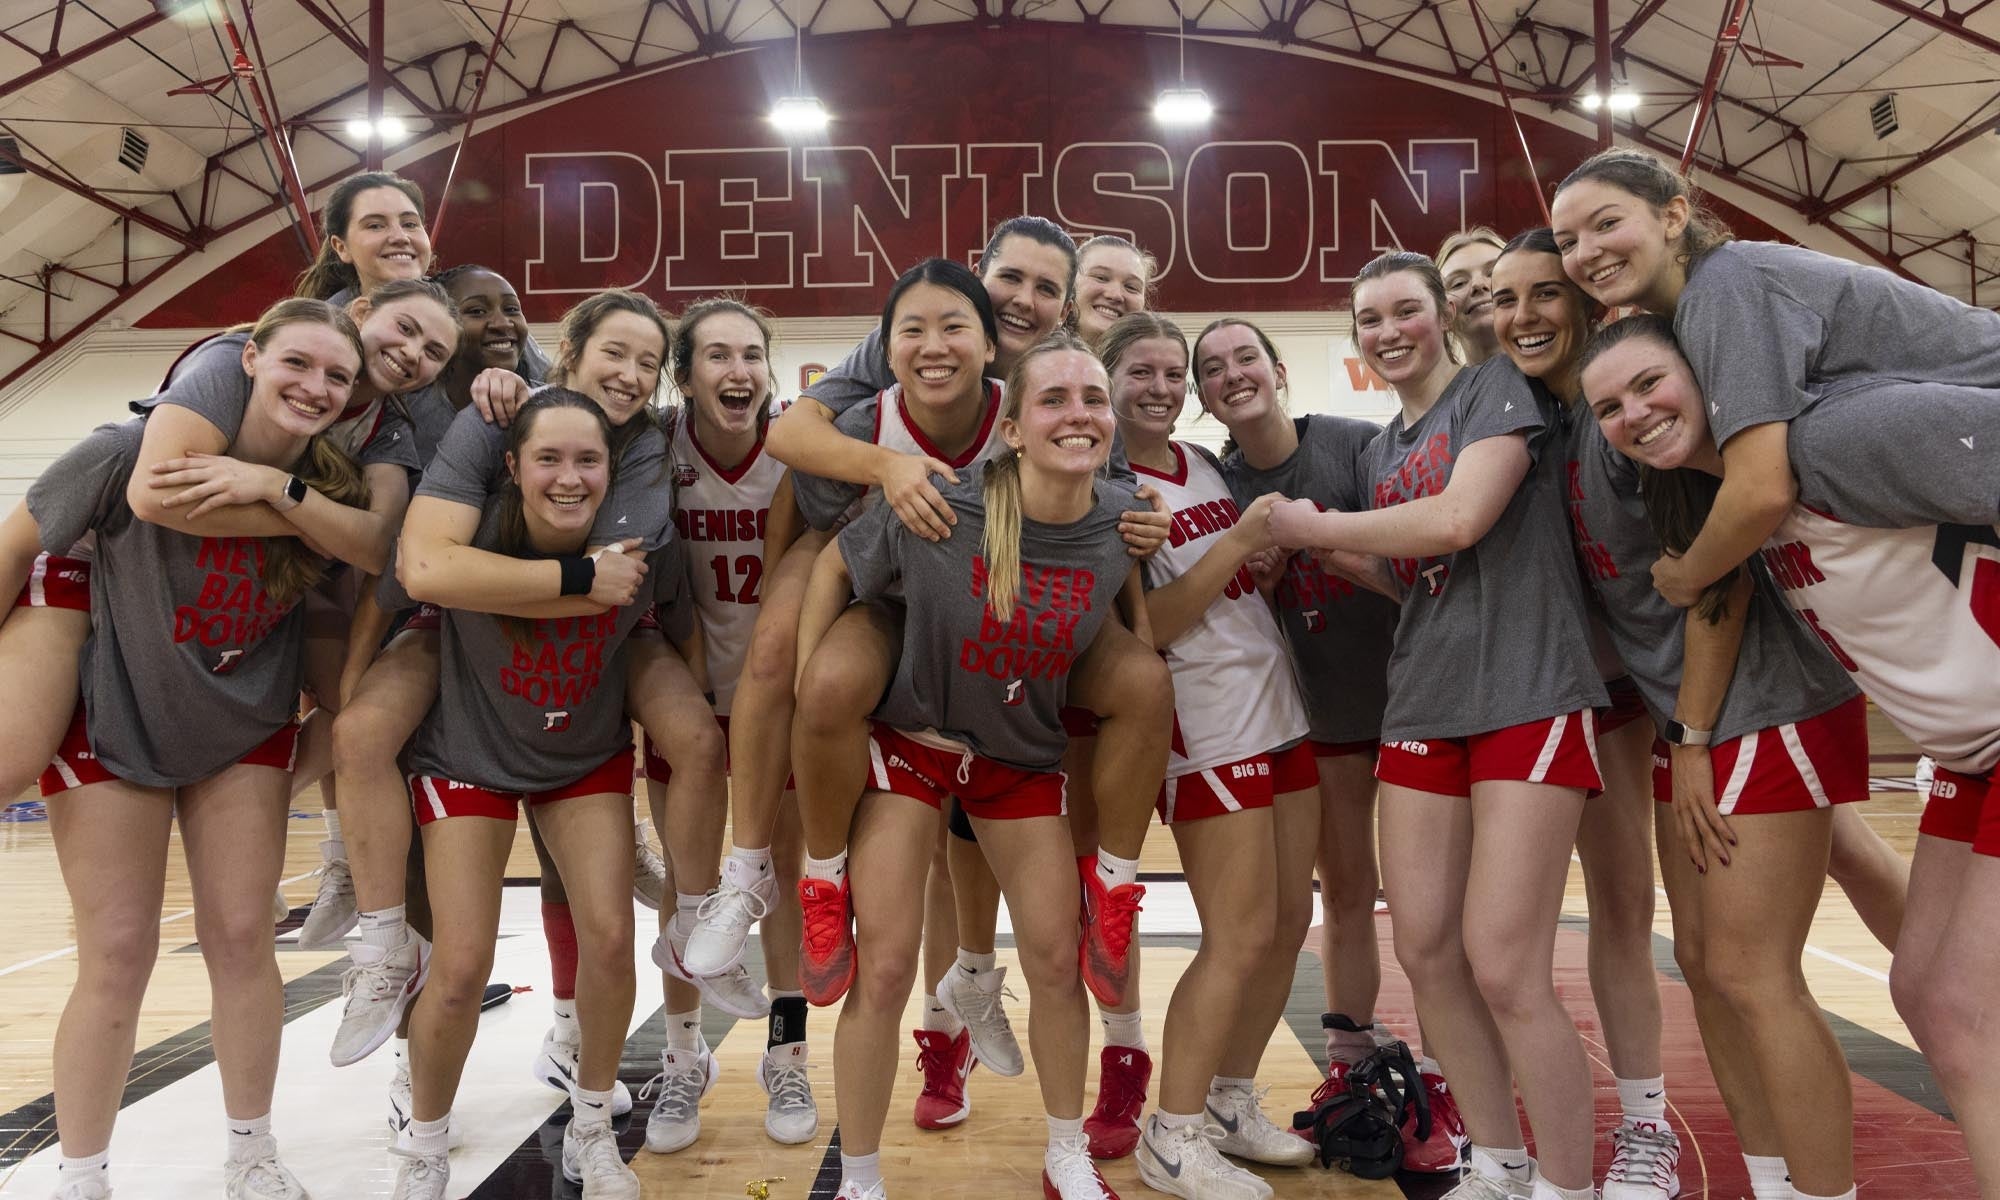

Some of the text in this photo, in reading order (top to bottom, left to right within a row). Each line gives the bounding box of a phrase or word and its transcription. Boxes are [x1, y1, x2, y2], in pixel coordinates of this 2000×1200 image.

[525, 139, 1479, 294] DENISON
[675, 508, 770, 542] DENISO
[1168, 498, 1241, 549] DENISO
[710, 555, 763, 605] 12
[970, 554, 1096, 612] NVER
[502, 605, 620, 641] EVER
[978, 602, 1081, 651] BACK
[959, 637, 1078, 682] DOWN
[1401, 740, 1428, 756] RED
[1231, 763, 1255, 779] BIG
[1931, 779, 1958, 799] RED
